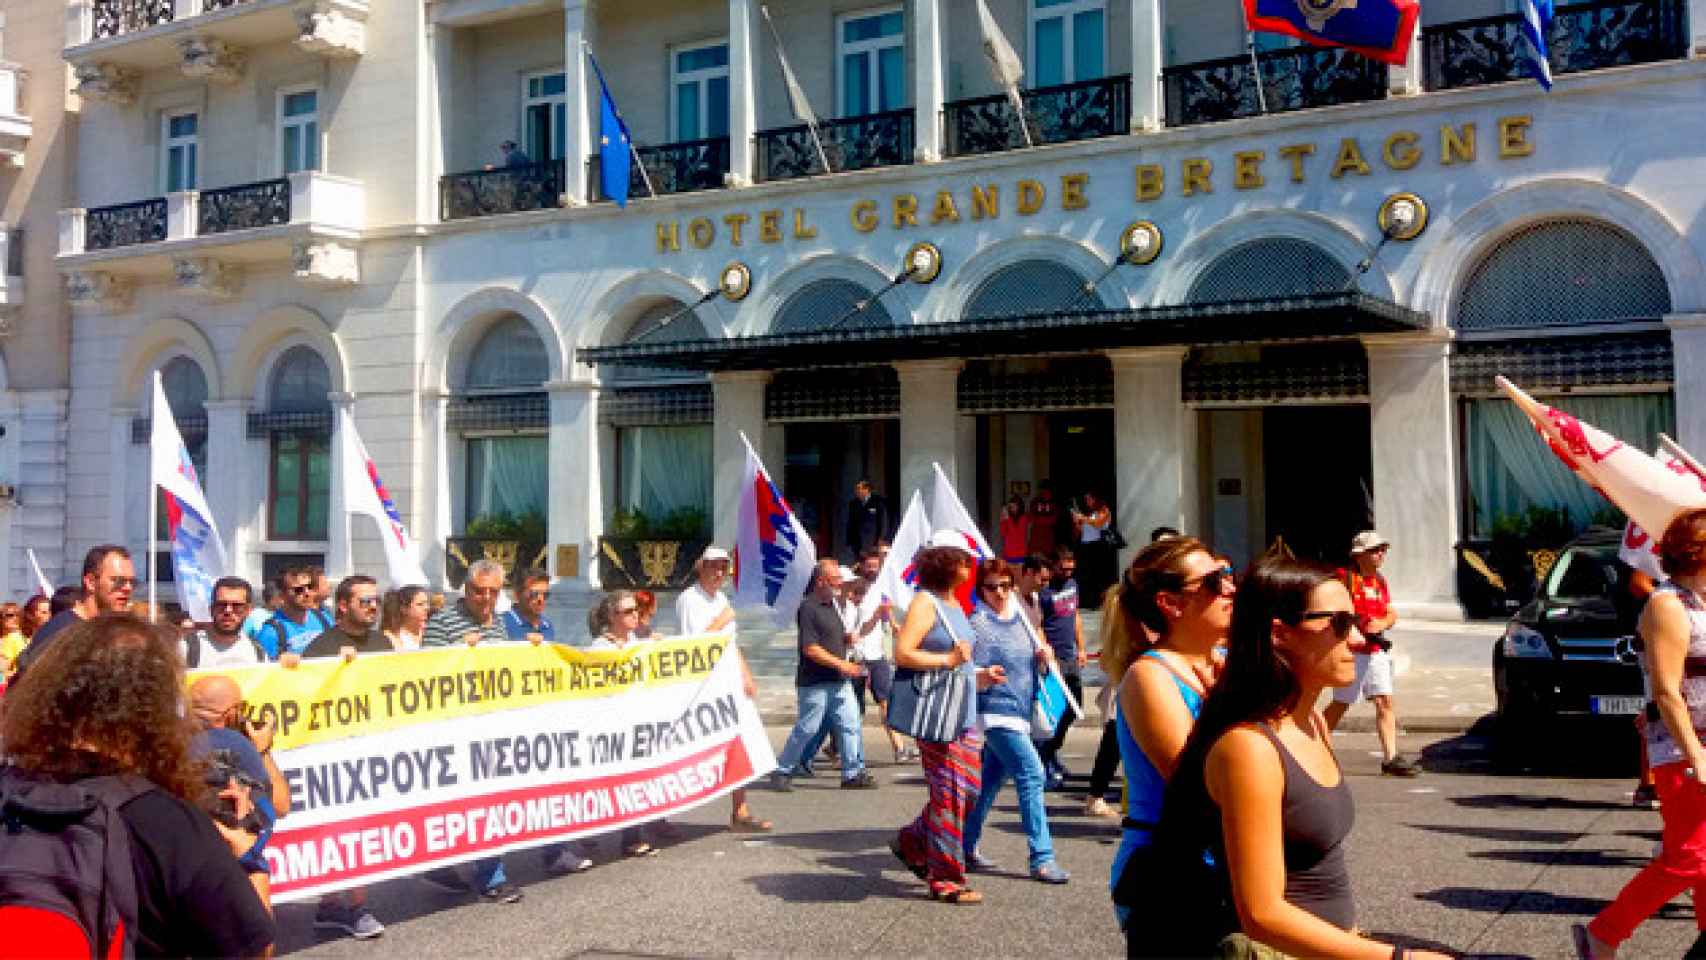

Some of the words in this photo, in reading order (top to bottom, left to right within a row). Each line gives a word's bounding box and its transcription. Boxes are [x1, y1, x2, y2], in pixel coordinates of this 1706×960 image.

[655, 207, 816, 252] HOTEL
[851, 172, 1089, 233] GRANDE
[1134, 112, 1536, 202] BRETAGNE
[308, 694, 371, 731] ΣΤΟΝ
[283, 745, 459, 812] ΕΝΙΧΡΟΥΣ
[262, 821, 417, 885] ΩΜΑΤΕΙΟ
